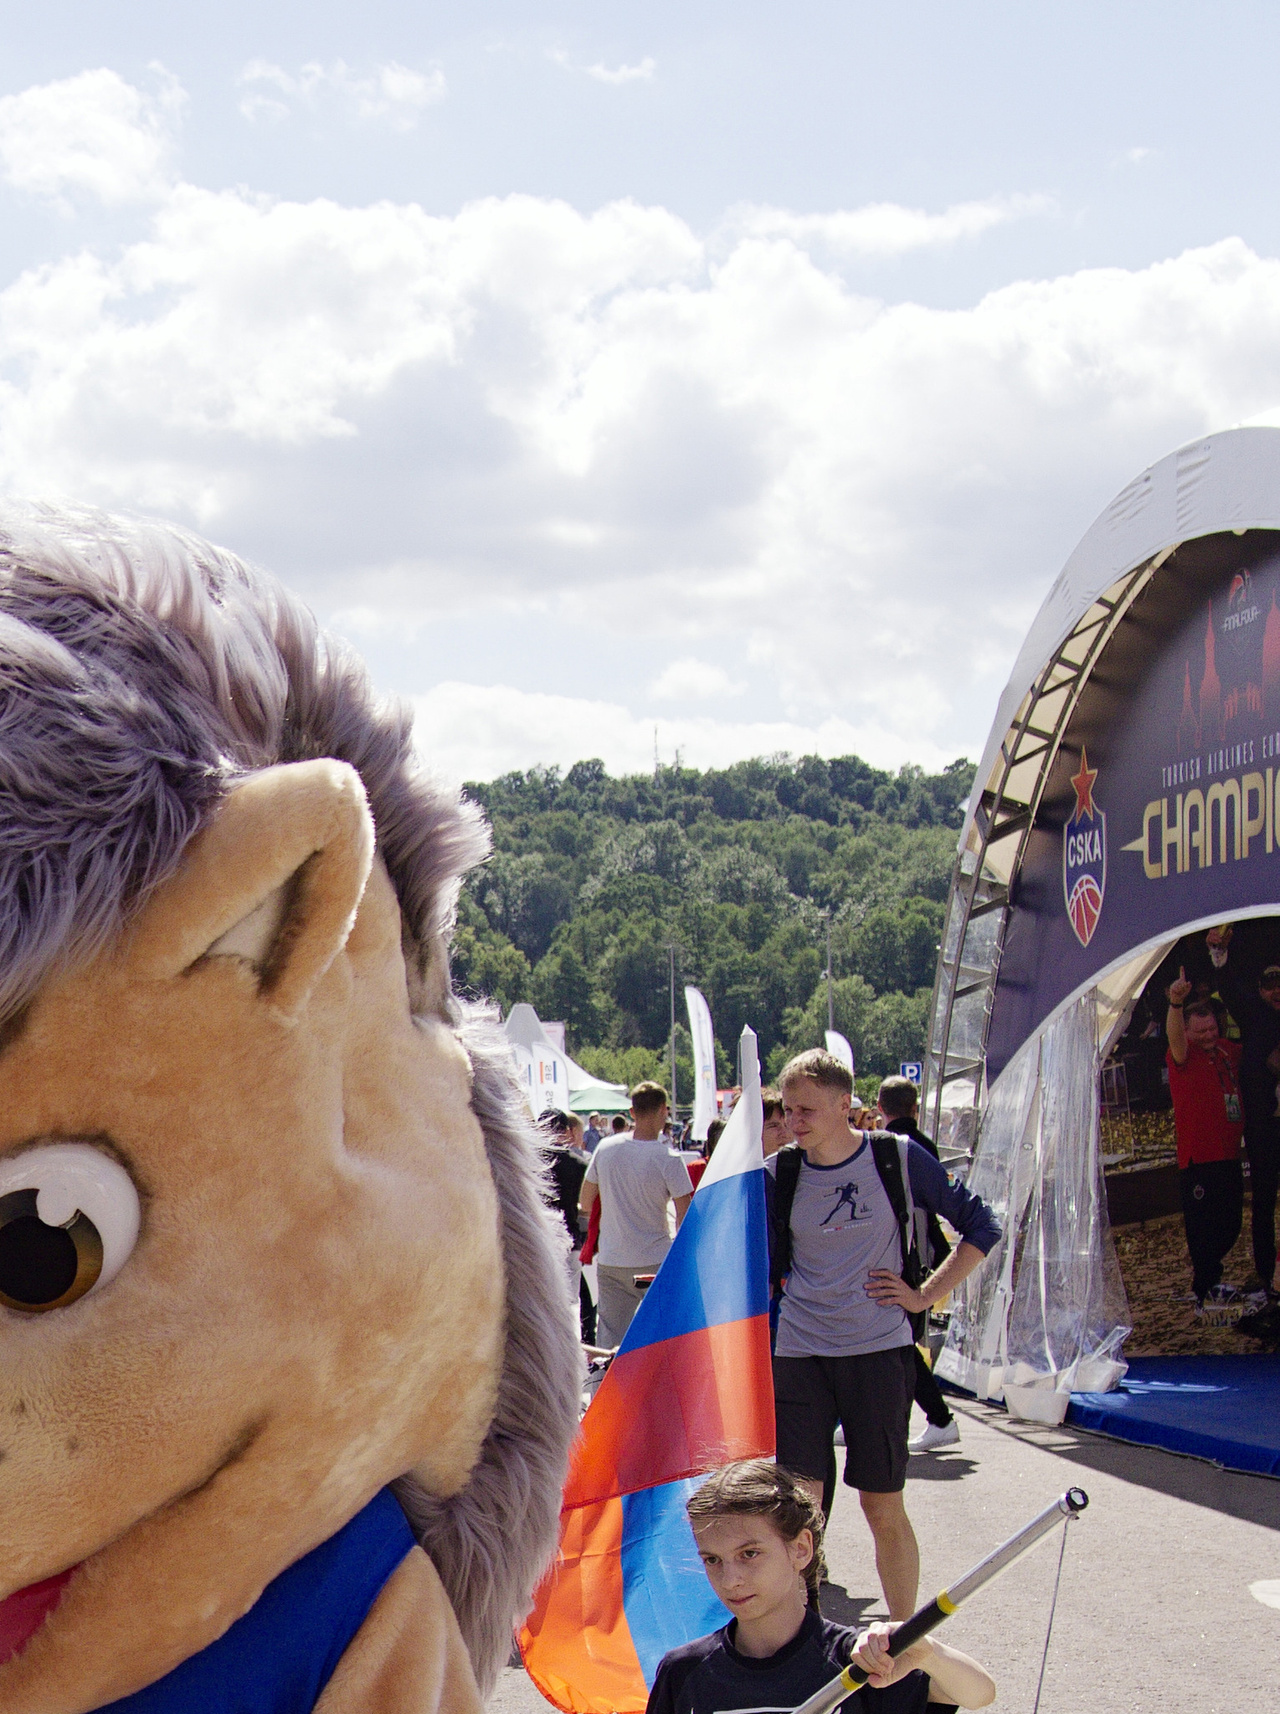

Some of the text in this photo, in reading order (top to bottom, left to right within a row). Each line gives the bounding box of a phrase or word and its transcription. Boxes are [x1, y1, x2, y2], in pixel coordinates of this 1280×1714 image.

[1208, 740, 1254, 775] AIRLINES
[1121, 767, 1280, 880] CHAMPI
[1067, 829, 1102, 869] CSKA
[906, 1065, 918, 1080] P
